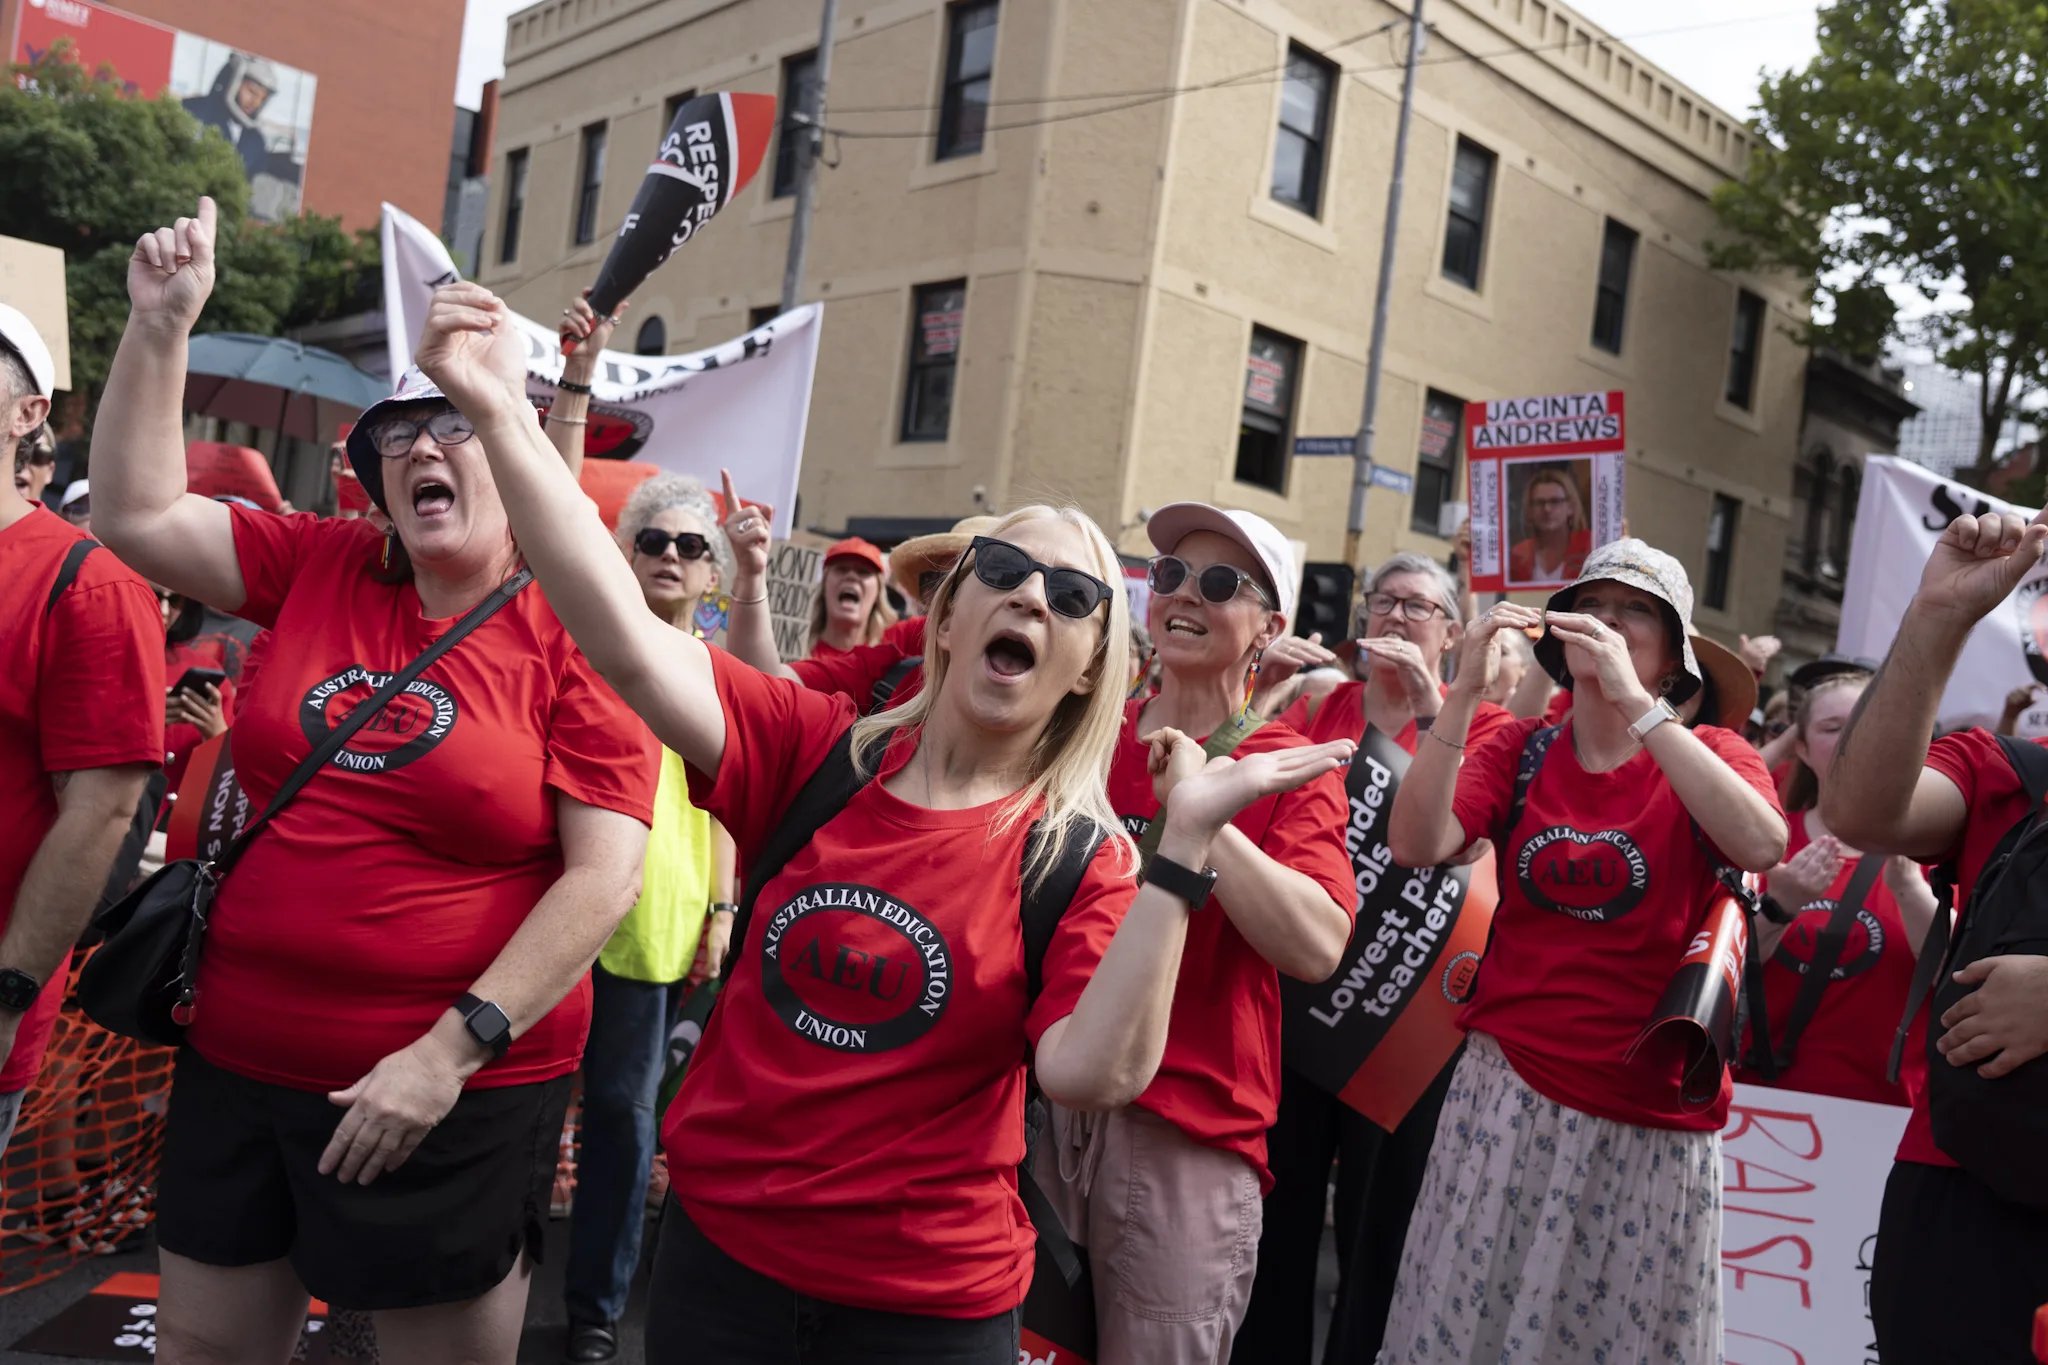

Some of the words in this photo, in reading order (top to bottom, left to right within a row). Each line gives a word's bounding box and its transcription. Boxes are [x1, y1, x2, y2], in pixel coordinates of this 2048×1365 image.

[1476, 416, 1618, 447] ANDREWS
[1488, 395, 1604, 423] JACINTA
[1487, 471, 1497, 526] POLITICS
[1487, 527, 1497, 560] FEED
[405, 681, 454, 738] EDUCATION
[334, 750, 387, 770] UNION
[208, 768, 235, 831] NOW
[1345, 755, 1391, 860] nded
[1518, 827, 1589, 879] AUSTRALIAN
[1590, 830, 1647, 889] EDUCATION
[1540, 858, 1617, 887] AEU
[1557, 904, 1604, 921] UNION
[765, 888, 881, 960] AUSTRALIAN
[879, 900, 948, 1017] EDUCATION
[788, 935, 912, 1000] AEU
[1308, 908, 1409, 1028] Lowest
[1400, 865, 1435, 911] pa
[1361, 875, 1460, 1017] teachers
[1452, 958, 1475, 992] AEU
[794, 1009, 866, 1048] UNION
